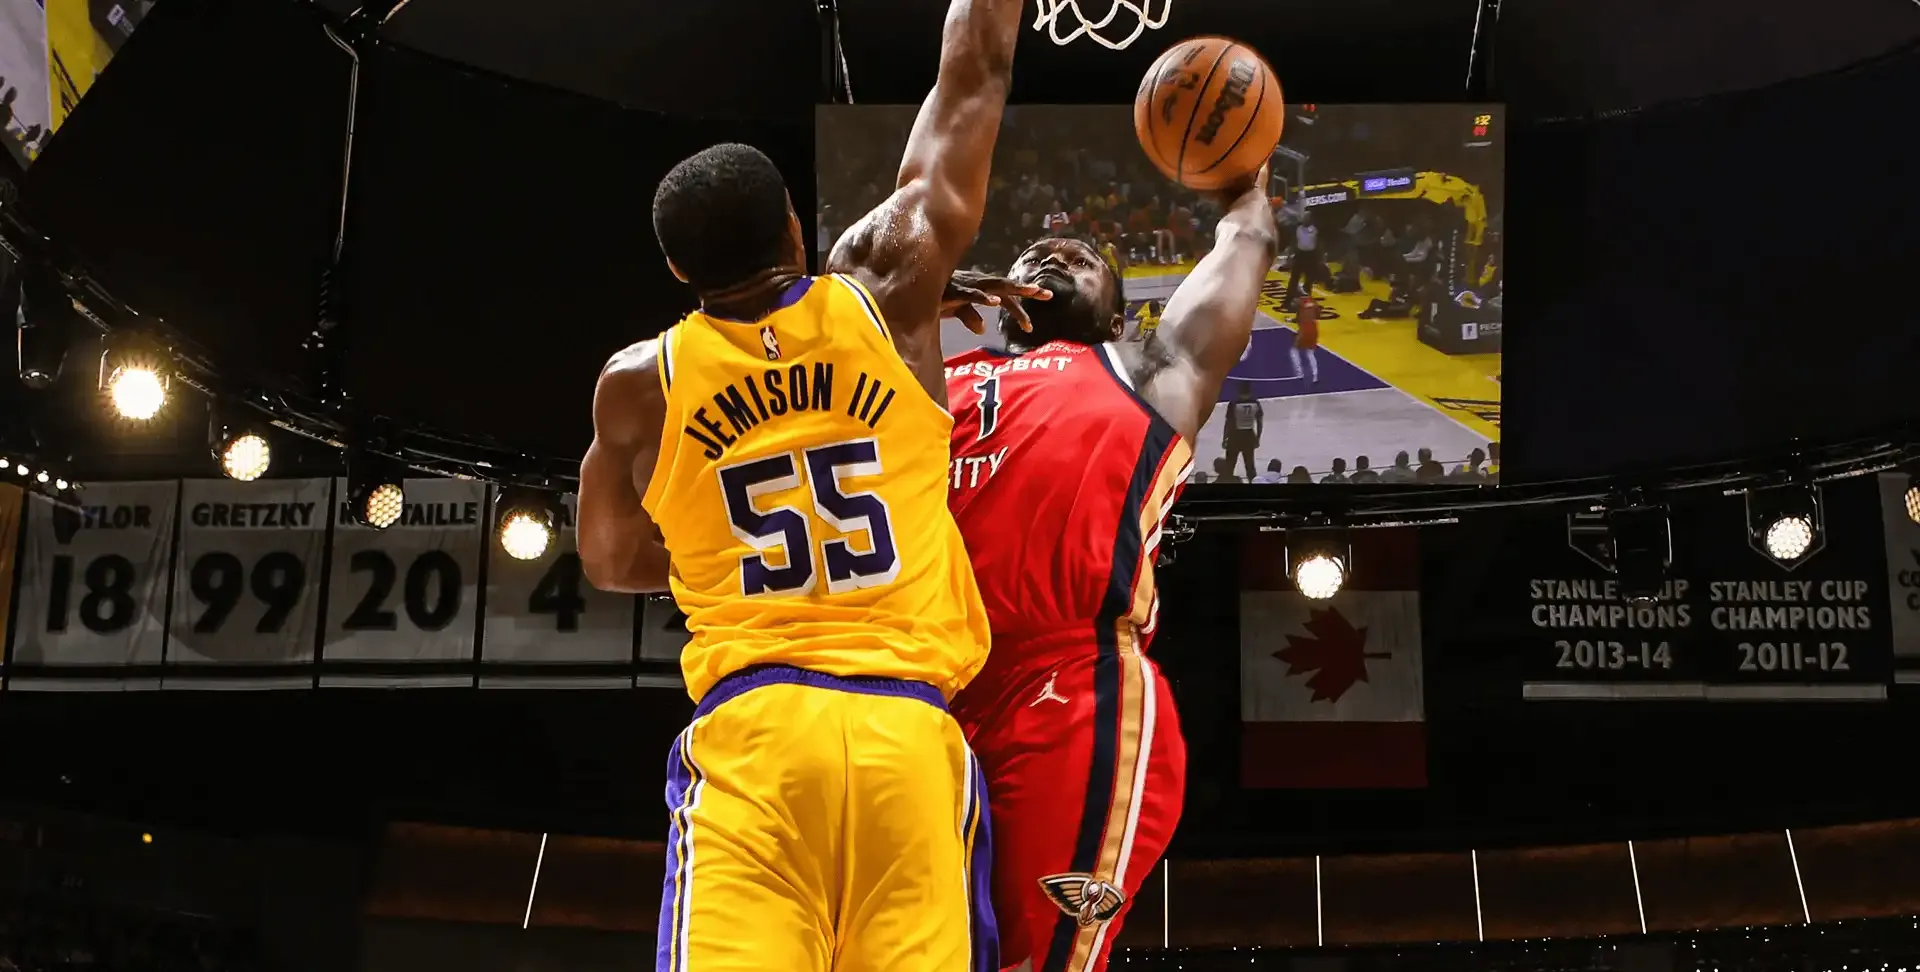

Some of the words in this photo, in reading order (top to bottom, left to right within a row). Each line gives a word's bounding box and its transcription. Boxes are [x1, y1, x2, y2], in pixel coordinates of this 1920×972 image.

[1195, 58, 1256, 146] Wilson
[1305, 192, 1347, 207] KERS.COM
[944, 356, 1073, 379] ESCENT
[684, 362, 834, 462] JEMISON
[847, 372, 896, 429] III
[974, 376, 1002, 441] 1
[948, 446, 1009, 490] ITY
[81, 504, 152, 530] YLOR
[192, 502, 315, 527] GRETZKY
[340, 502, 478, 527] TAILLE
[715, 437, 902, 597] 55
[47, 554, 137, 634] 18
[190, 551, 306, 634] 99
[342, 550, 462, 632] 20
[529, 553, 585, 632] 4
[1530, 578, 1620, 601] STANLE
[1658, 577, 1690, 601] UP
[1709, 580, 1813, 602] STANLEY
[1820, 580, 1869, 602] CUP
[1531, 604, 1692, 629] CHAMPIONS
[1710, 606, 1872, 631] CHAMPIONS
[1554, 640, 1674, 670] 2013-14
[1737, 642, 1851, 672] 2011-12
